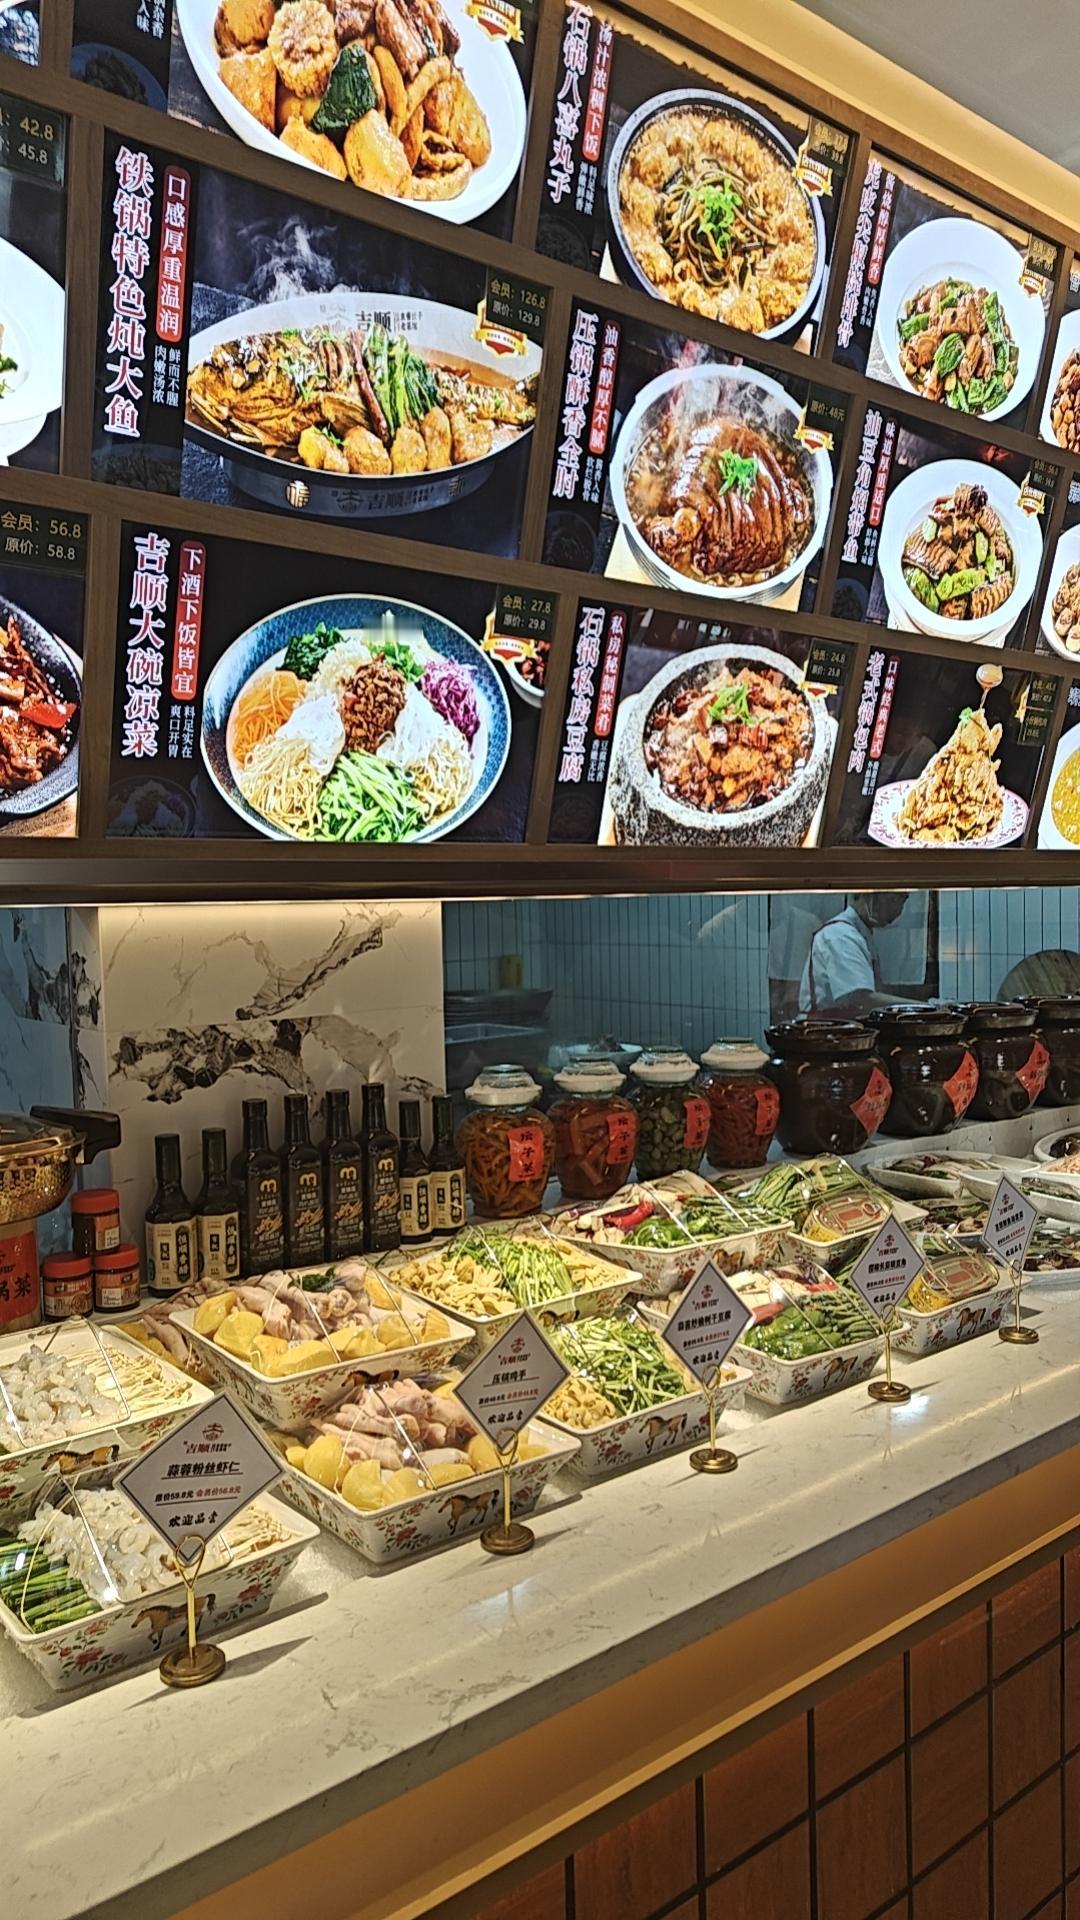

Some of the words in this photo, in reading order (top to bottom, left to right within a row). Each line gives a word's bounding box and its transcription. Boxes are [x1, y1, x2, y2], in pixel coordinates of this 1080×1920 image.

[103, 146, 154, 437] 铁锅特色炖大鱼
[159, 173, 186, 337] 口感厚重温润
[152, 345, 167, 404] 肉嫩汤浓
[166, 348, 181, 407] 鲜而不腥
[552, 309, 599, 499] 压锅酥香金肘
[121, 532, 170, 758] 吉顺大碗凉菜
[174, 548, 203, 694] 下酒下饭皆宜
[558, 606, 605, 782] 石锅私房豆腐
[847, 651, 885, 773] 老式锅包肉
